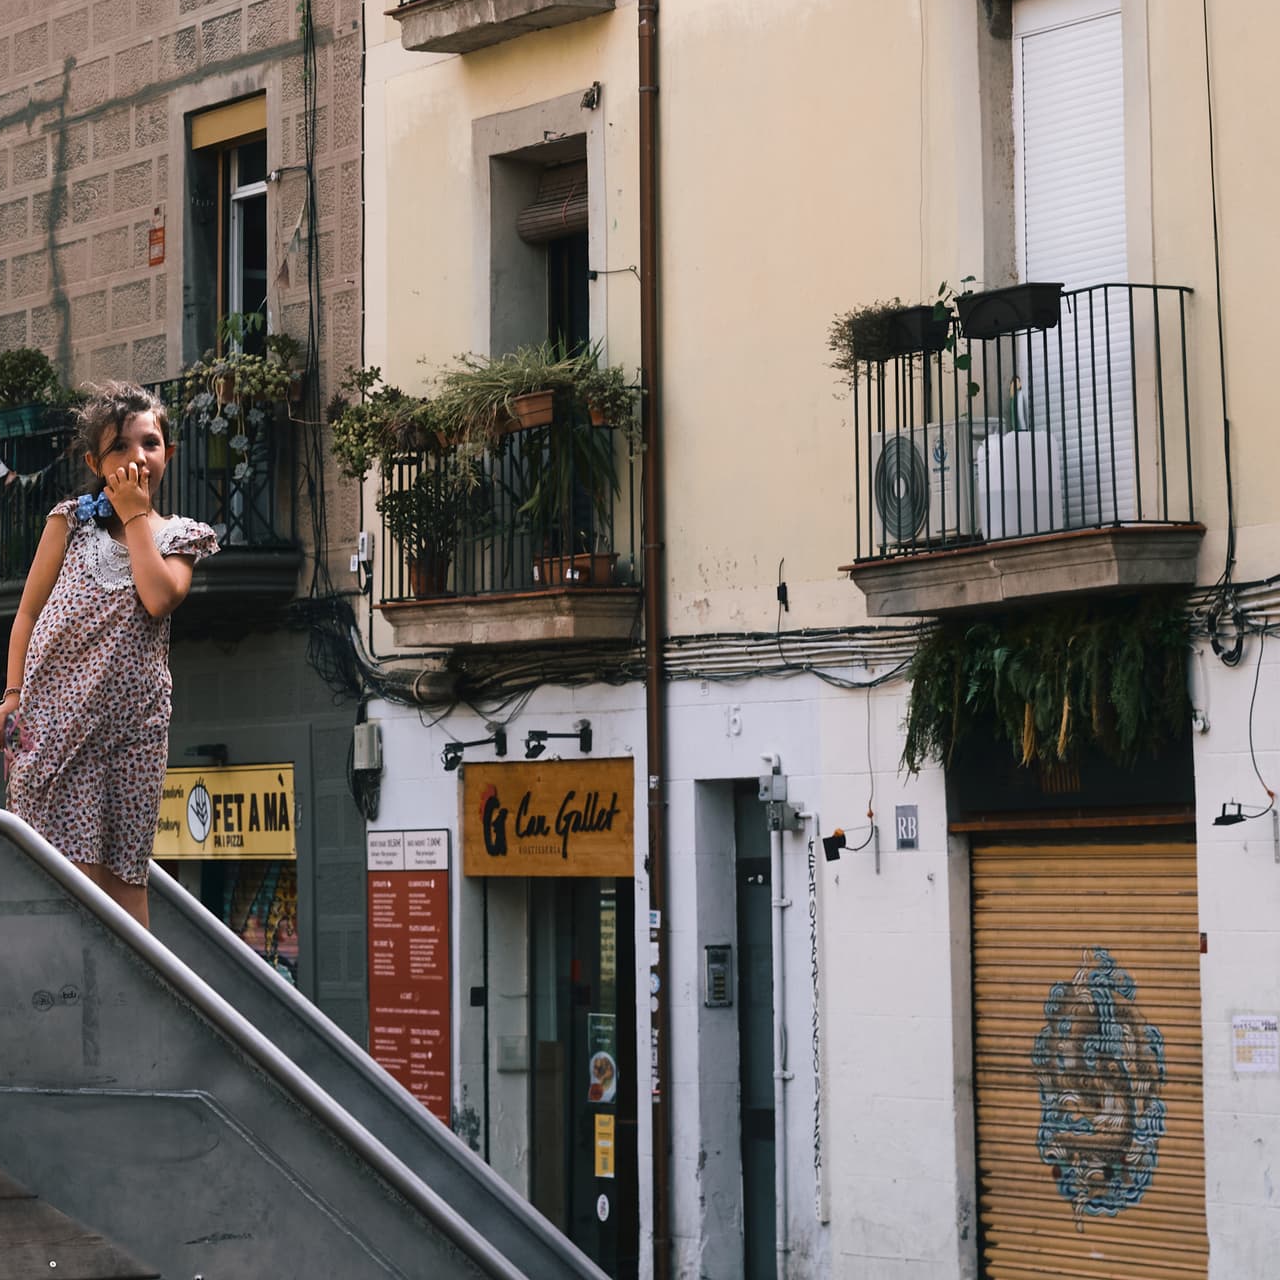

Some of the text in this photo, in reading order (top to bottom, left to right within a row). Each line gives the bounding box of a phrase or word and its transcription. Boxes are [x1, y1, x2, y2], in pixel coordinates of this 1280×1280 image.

[212, 773, 290, 833] FET A MÀ
[226, 834, 245, 847] PIZZA
[515, 790, 619, 859] Can Gallet
[898, 816, 917, 839] RB
